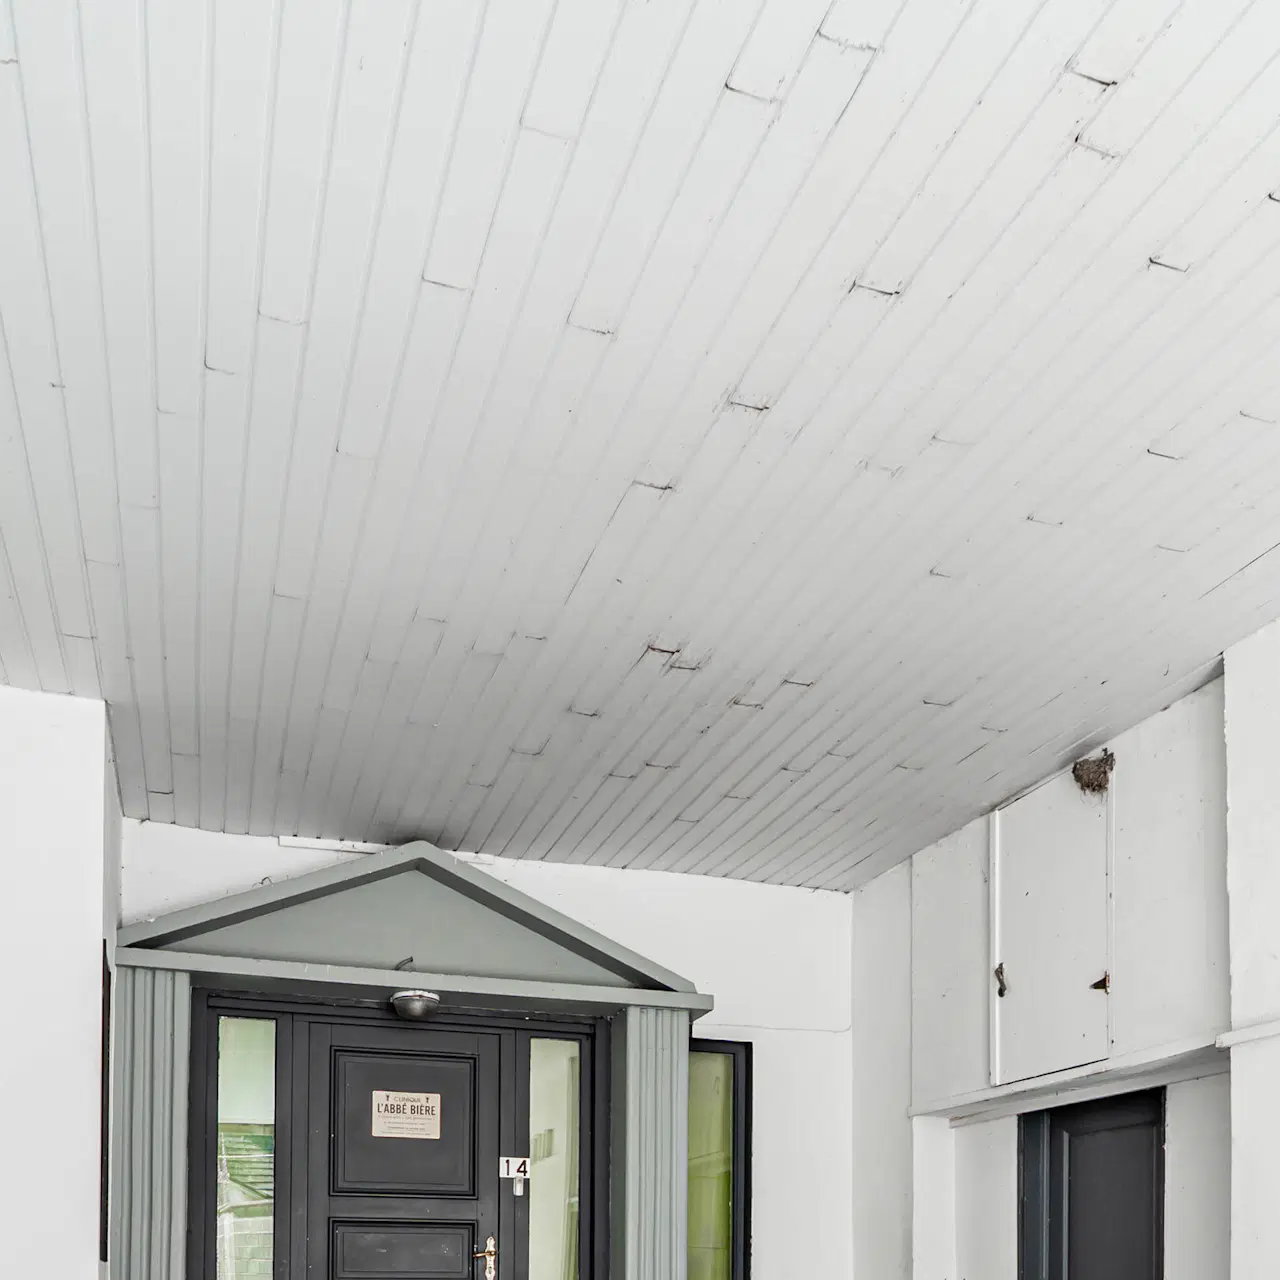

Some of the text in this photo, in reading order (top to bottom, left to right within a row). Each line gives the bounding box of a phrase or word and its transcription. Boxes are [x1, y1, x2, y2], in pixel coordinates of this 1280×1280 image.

[377, 1102, 436, 1116] L'ABBÉ BIÈRE
[505, 1159, 528, 1177] 14
